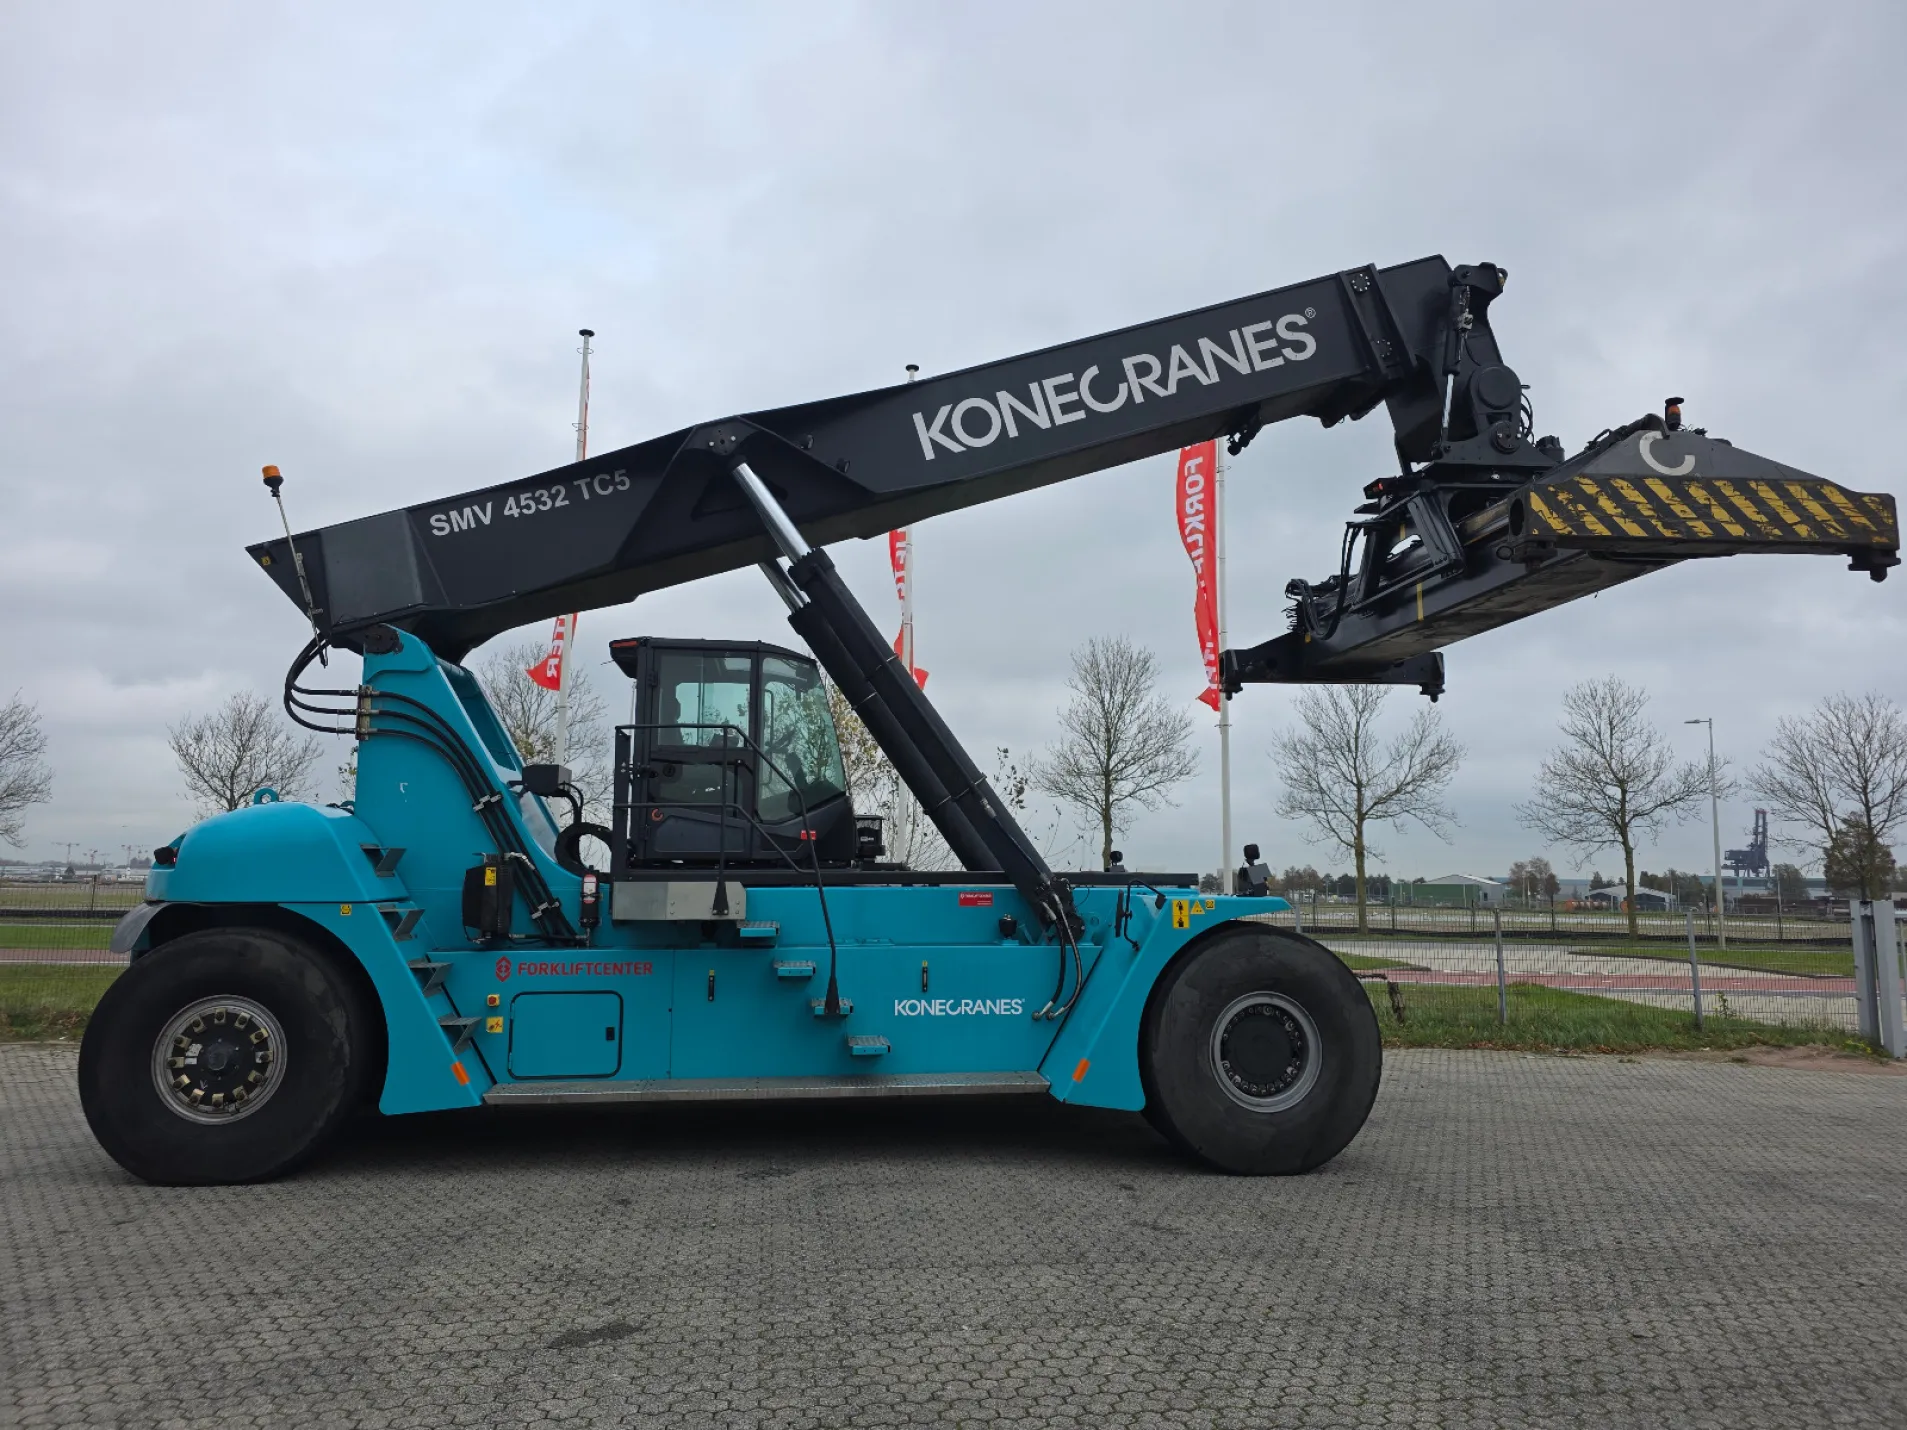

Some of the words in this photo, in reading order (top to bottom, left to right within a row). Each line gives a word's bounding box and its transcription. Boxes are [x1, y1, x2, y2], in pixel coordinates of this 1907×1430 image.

[429, 501, 493, 536] SMV
[503, 485, 570, 518] 4532
[573, 469, 631, 499] TC5
[517, 961, 653, 976] FORKLIFTCENTER
[894, 998, 1023, 1016] KONECRANES
